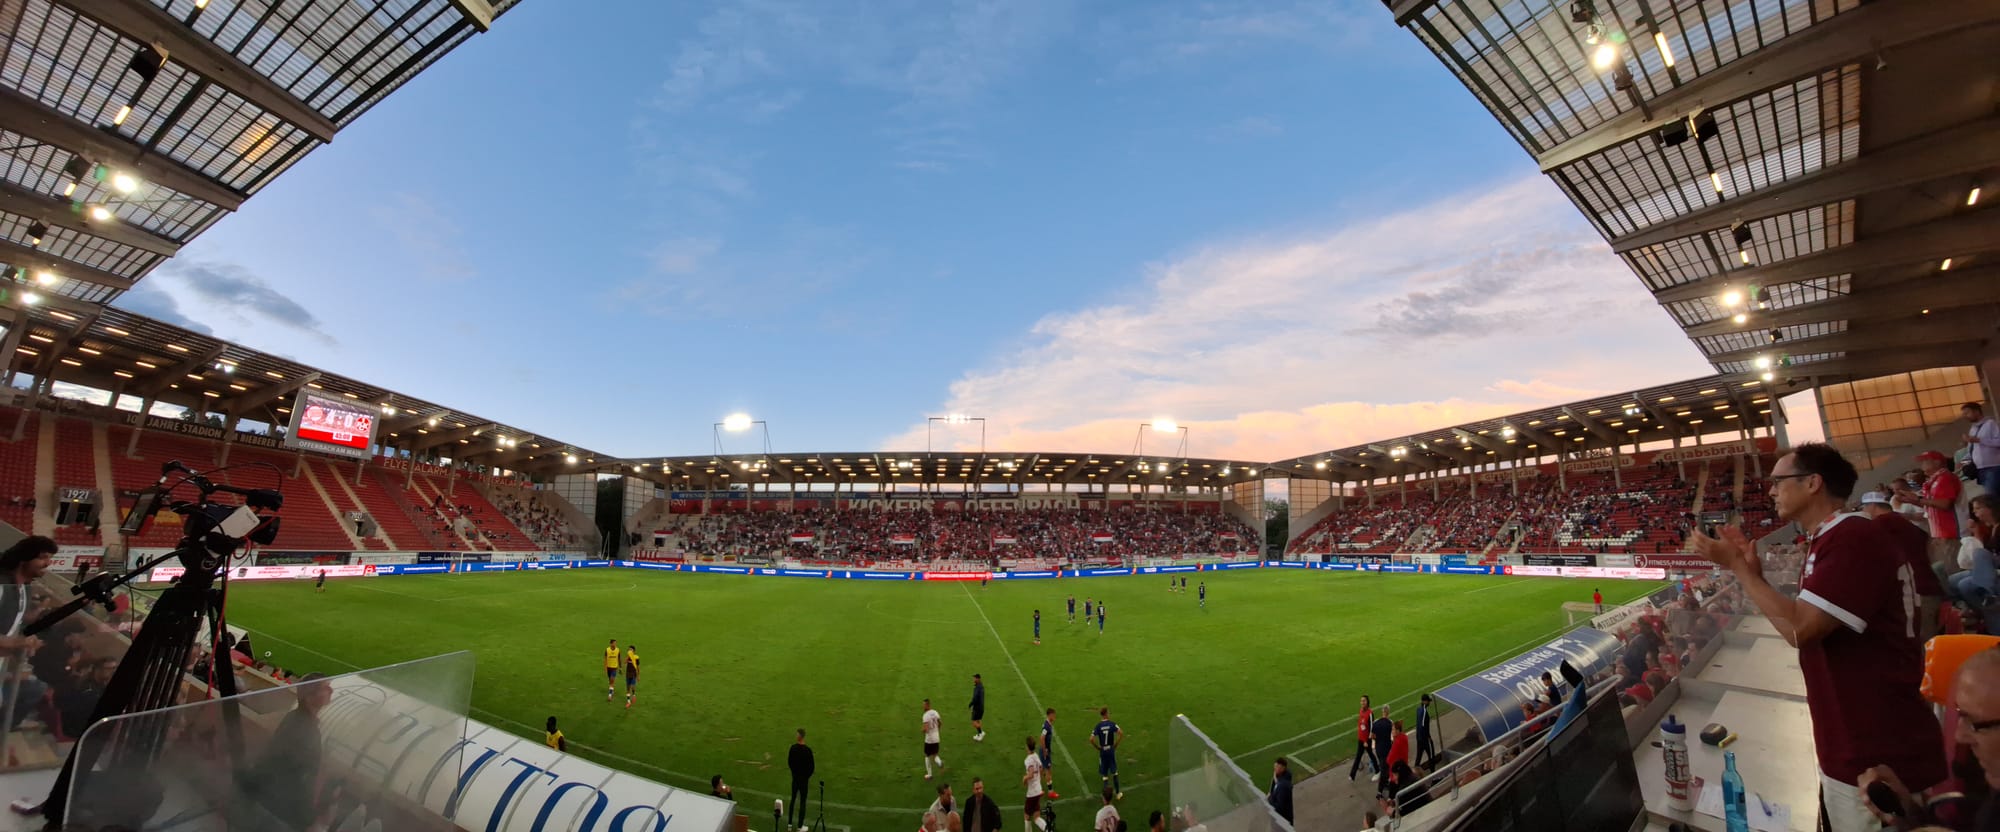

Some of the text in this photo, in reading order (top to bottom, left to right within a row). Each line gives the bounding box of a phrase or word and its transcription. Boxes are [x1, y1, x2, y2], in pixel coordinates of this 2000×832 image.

[147, 416, 179, 431] JAHRE
[181, 424, 222, 439] STADION
[1663, 445, 1746, 461] Glabsbräu
[1567, 458, 1630, 472] Glaabsbru
[67, 489, 90, 499] 1921
[849, 500, 935, 512] KICKERS
[1481, 649, 1557, 684] Stadtwerke
[1102, 730, 1109, 745] 7
